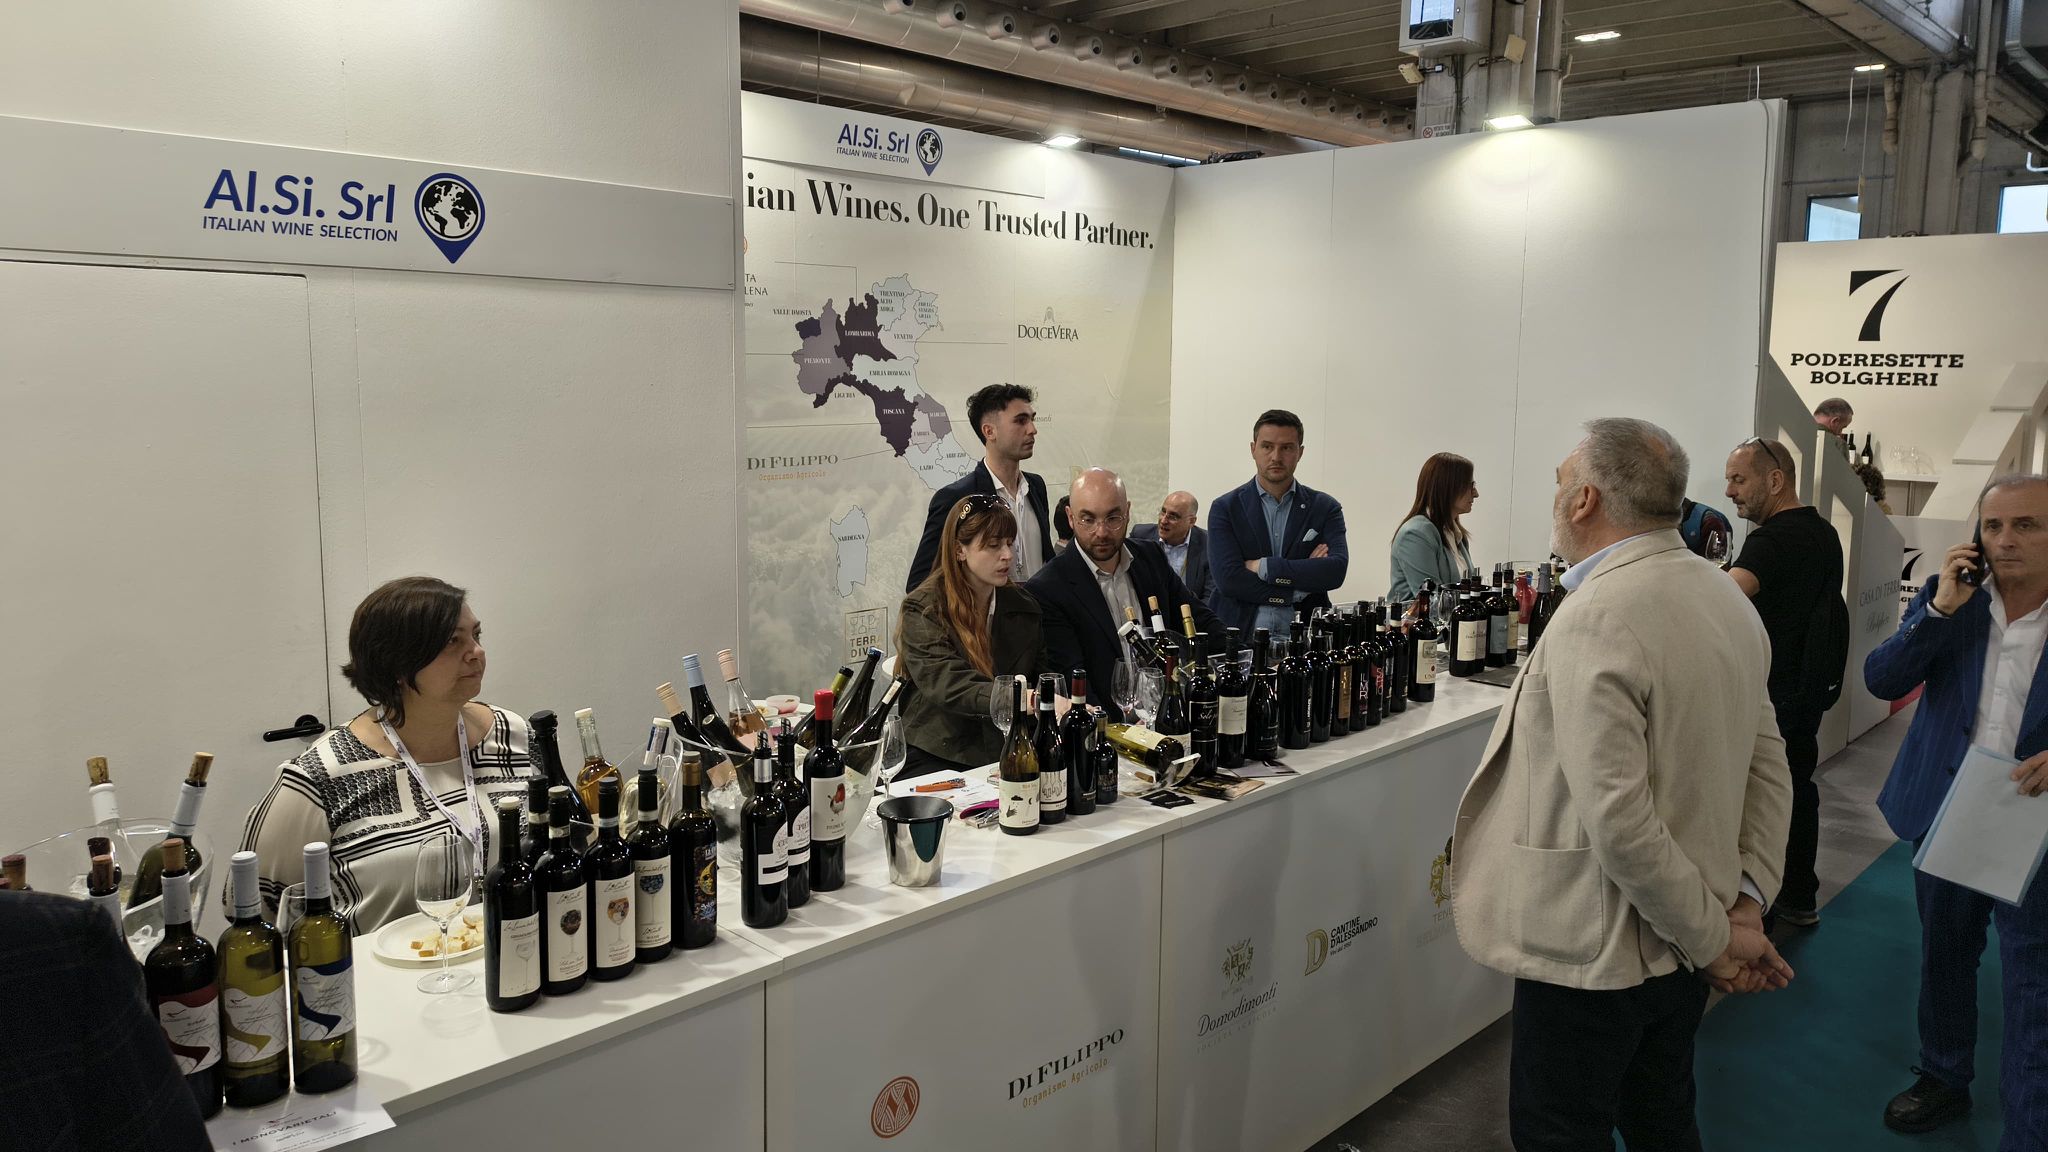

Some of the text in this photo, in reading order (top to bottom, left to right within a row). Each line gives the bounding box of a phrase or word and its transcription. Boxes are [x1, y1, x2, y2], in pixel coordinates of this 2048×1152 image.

[887, 131, 910, 154] Srl
[837, 147, 910, 164] ITALIAN WINE SELECTION
[338, 180, 396, 224] Srl
[806, 178, 911, 224] Wines.
[917, 192, 970, 230] One
[977, 199, 1067, 240] Trusted
[1074, 212, 1155, 250] Partner.
[203, 216, 398, 242] ITALIAN WINE SELECTION
[1790, 353, 1965, 369] PODERESETTE
[1809, 371, 1939, 387] BOLGHERI
[1330, 916, 1361, 938] CANTINE
[1197, 982, 1279, 1037] Domodimonti
[1022, 1058, 1108, 1108] Organismo Agricolo
